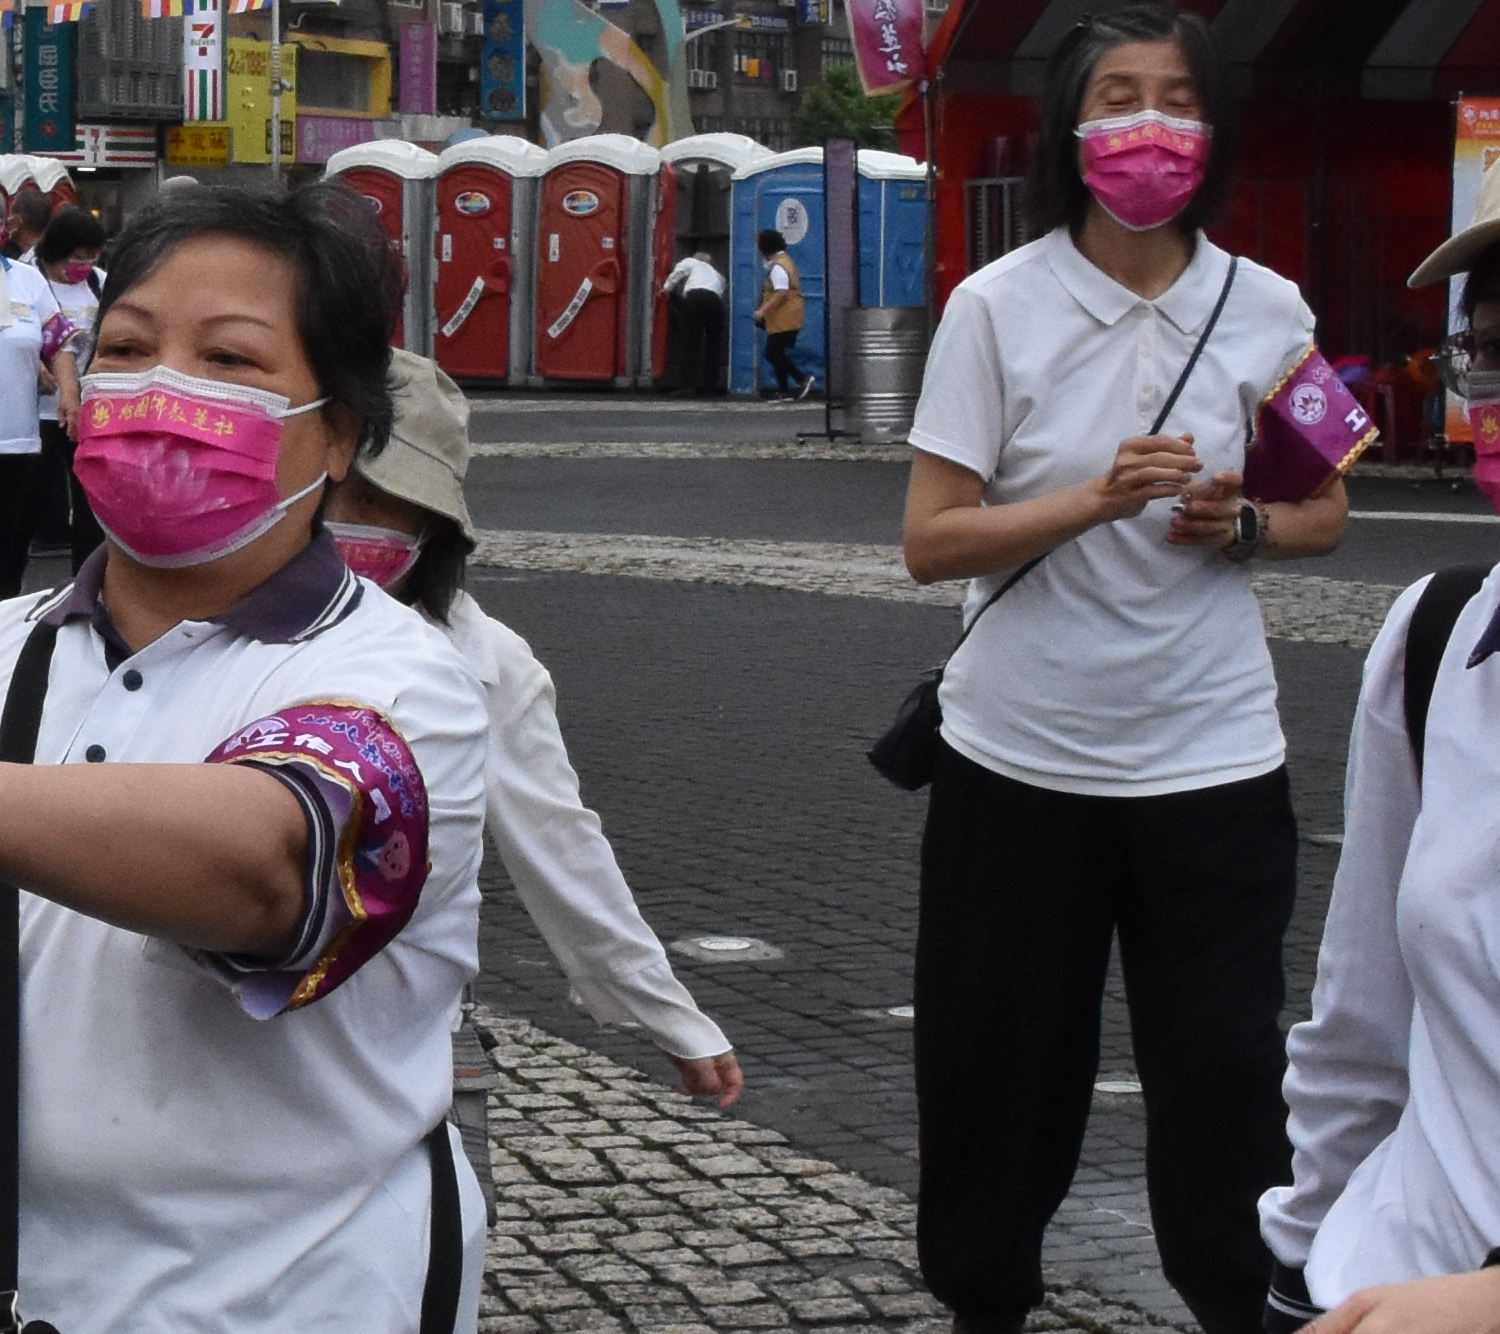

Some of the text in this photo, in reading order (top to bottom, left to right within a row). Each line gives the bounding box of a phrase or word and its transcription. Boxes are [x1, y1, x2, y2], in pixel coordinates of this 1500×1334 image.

[118, 394, 235, 436] 桃園佛教蓮社
